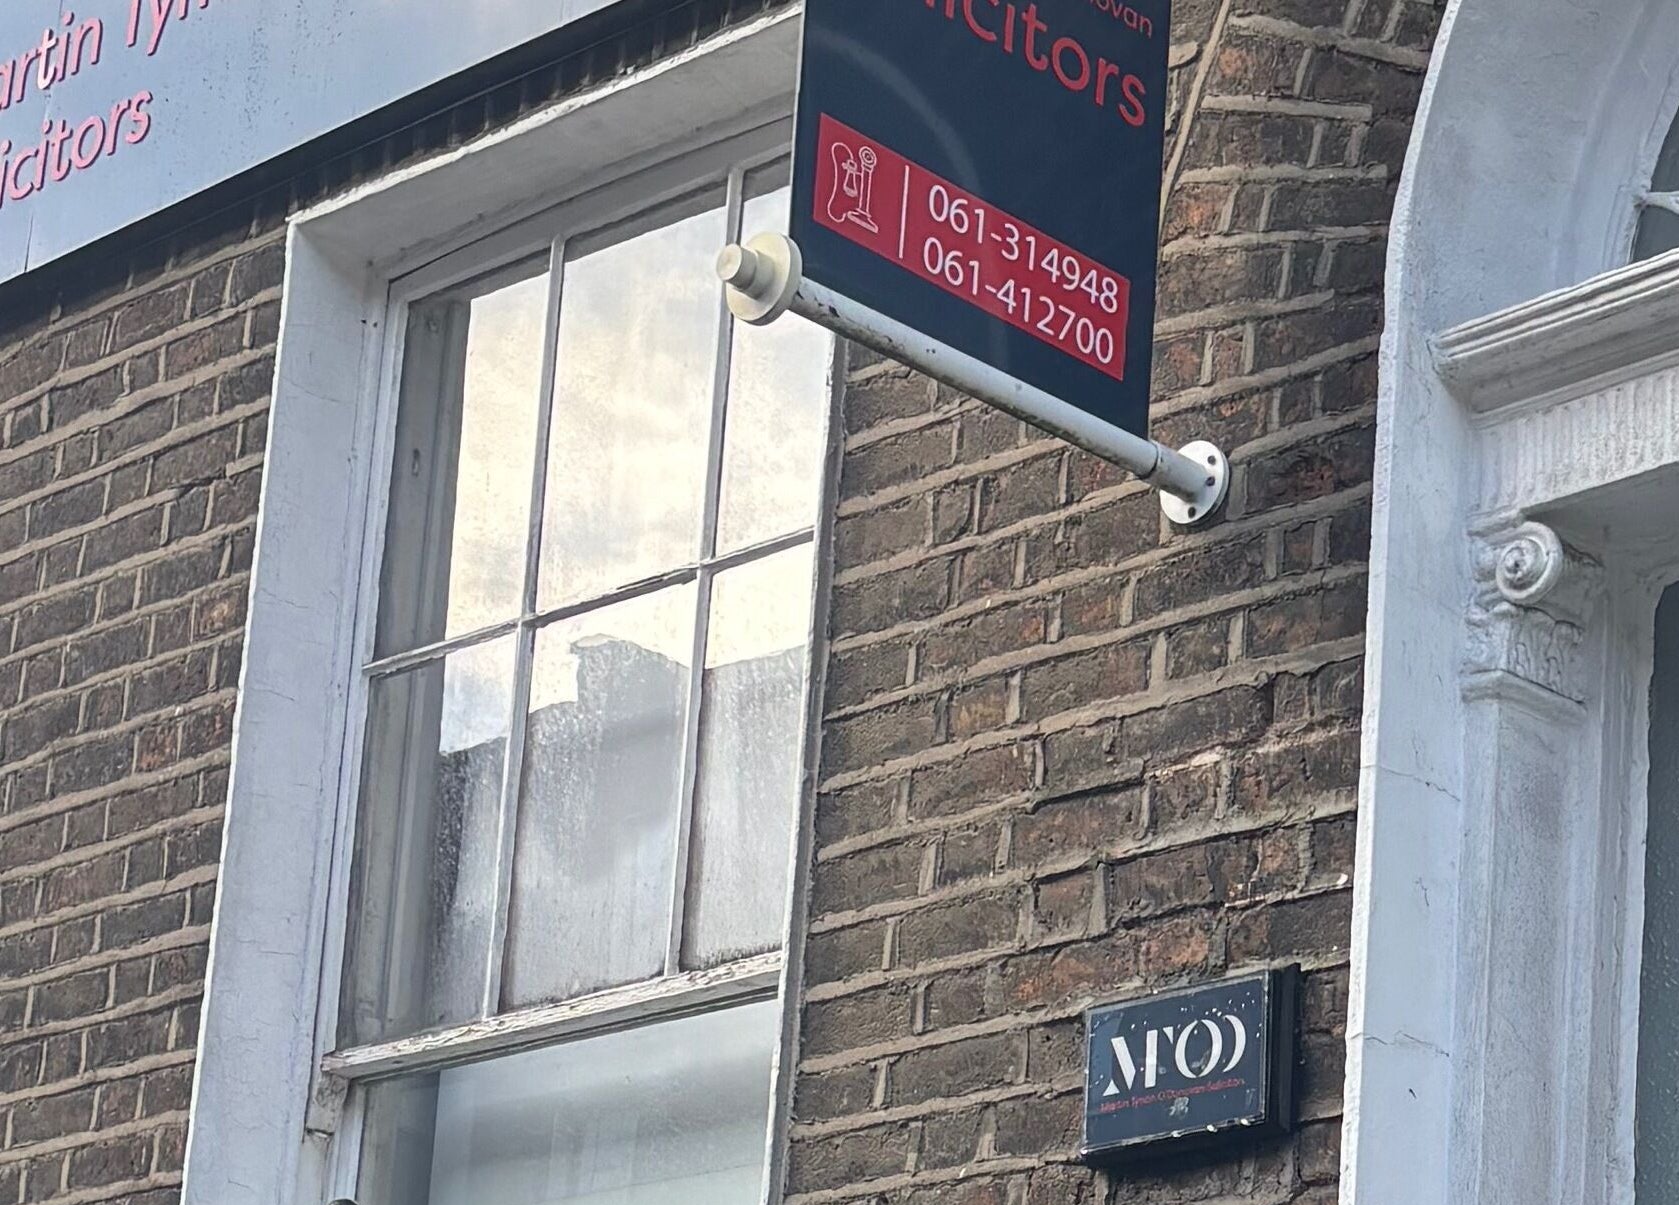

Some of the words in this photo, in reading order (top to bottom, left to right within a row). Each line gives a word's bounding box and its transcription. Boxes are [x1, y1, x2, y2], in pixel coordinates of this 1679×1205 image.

[924, 0, 1146, 127] citors
[923, 239, 1114, 365] 061-412700
[928, 184, 1118, 314] 061-314948
